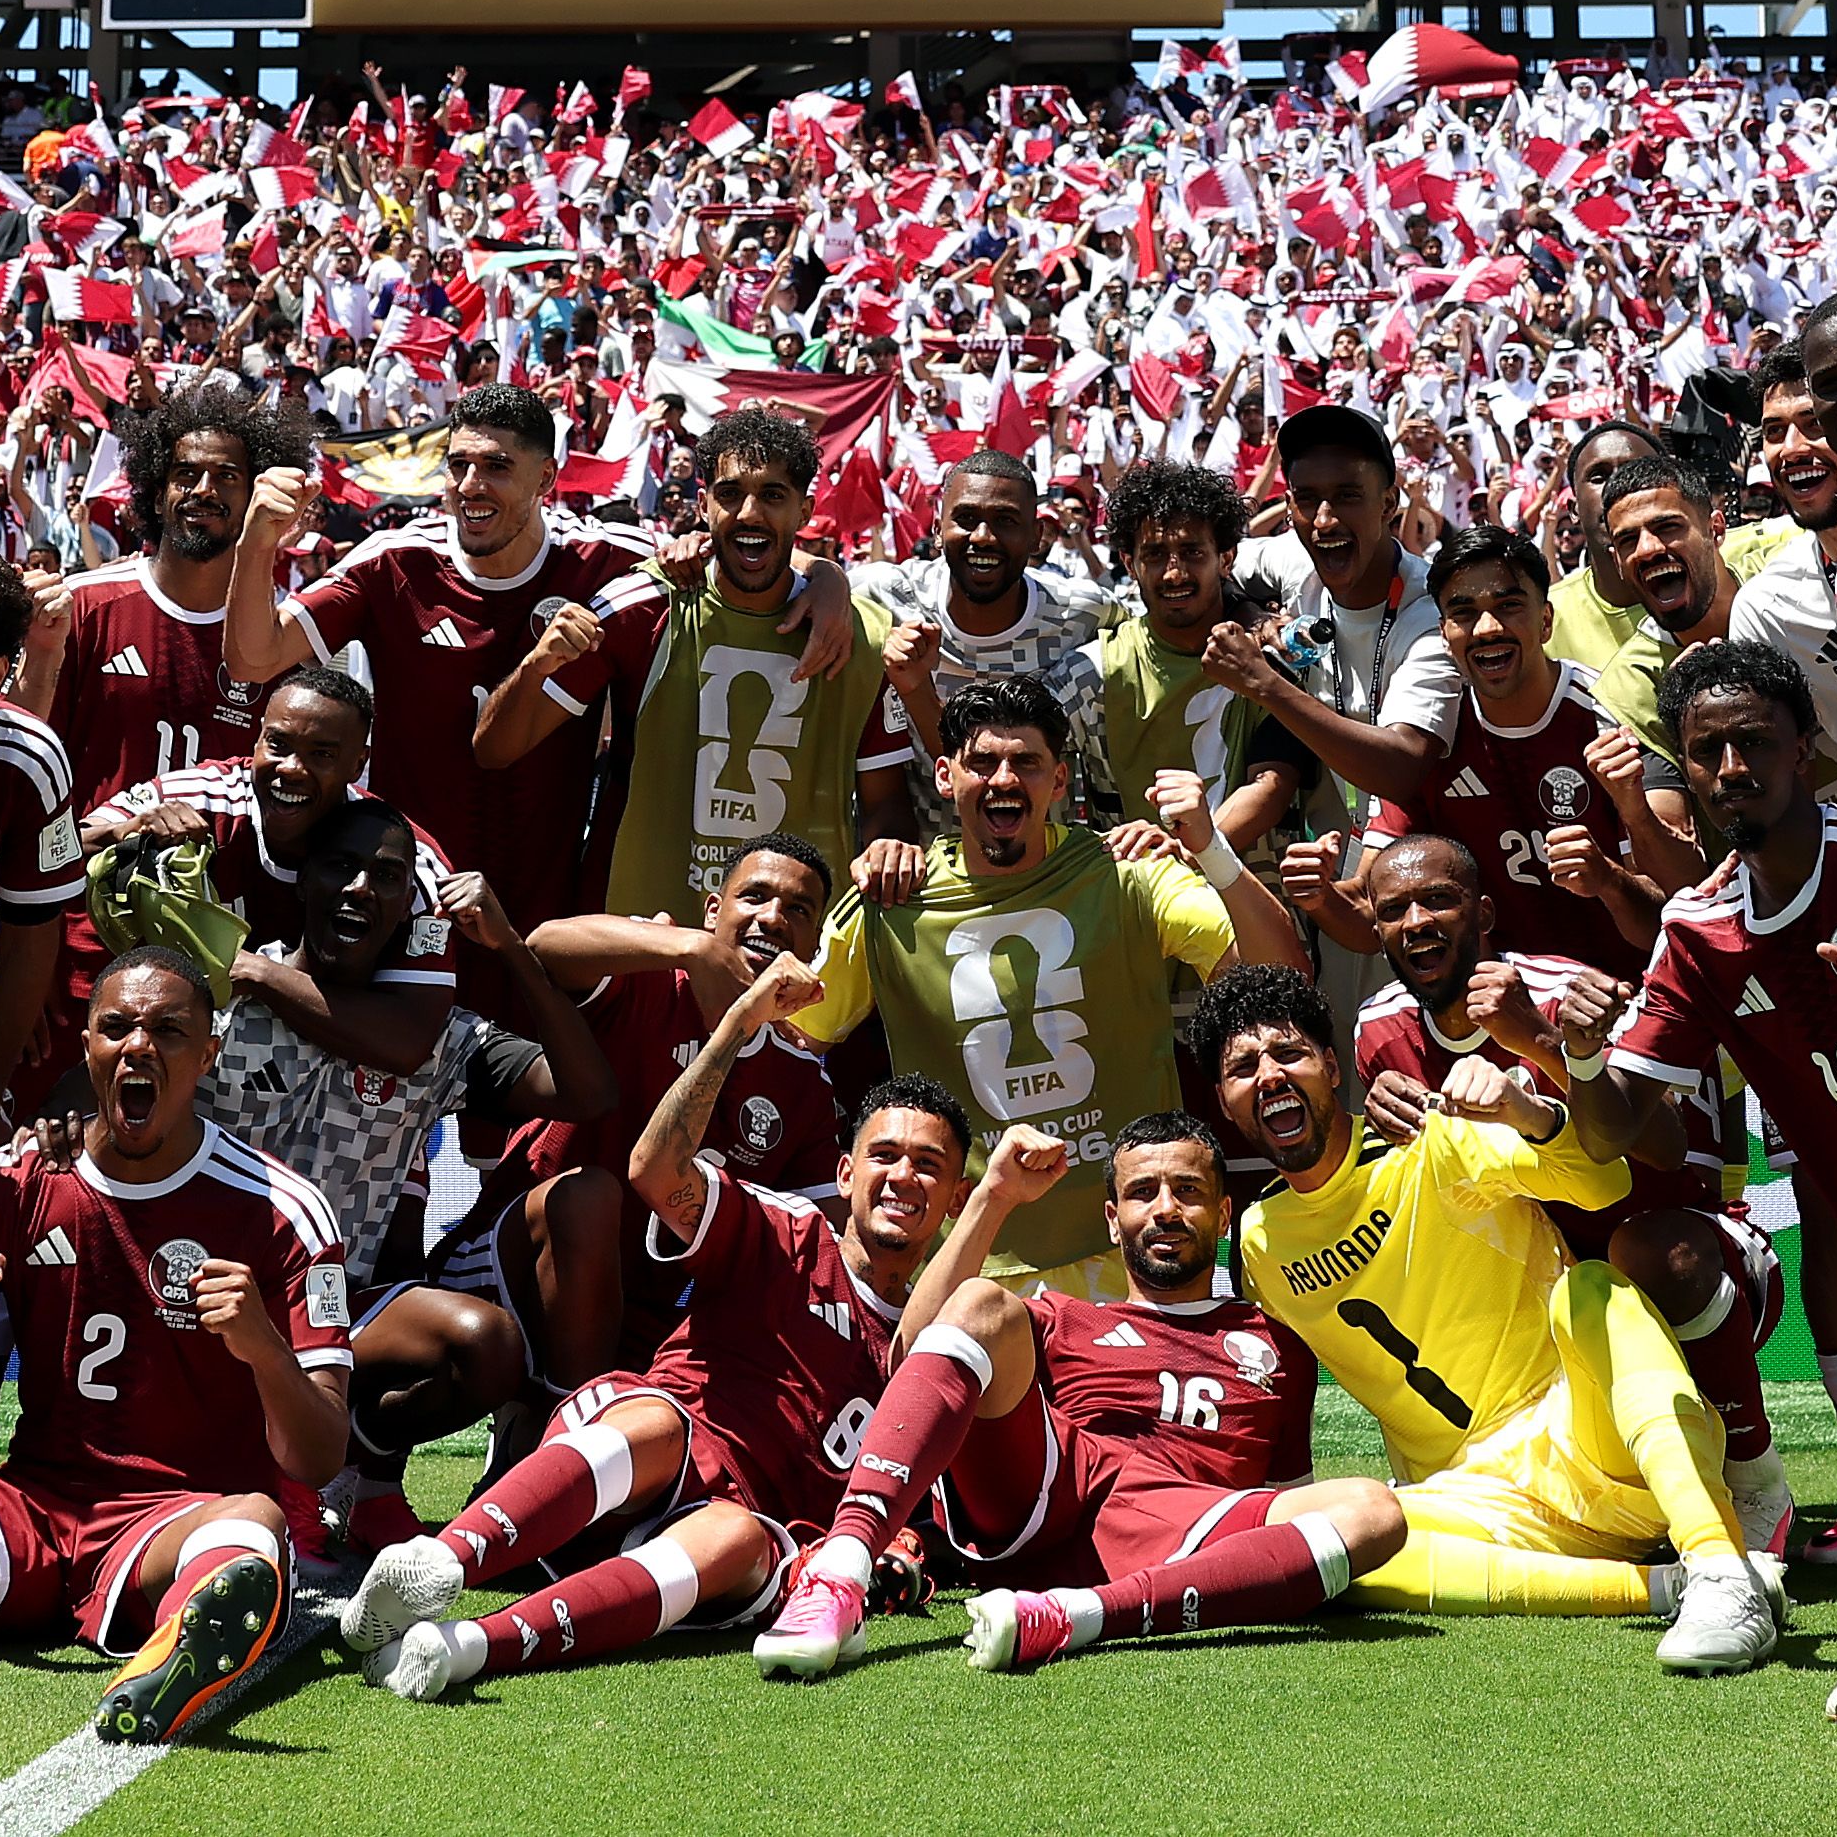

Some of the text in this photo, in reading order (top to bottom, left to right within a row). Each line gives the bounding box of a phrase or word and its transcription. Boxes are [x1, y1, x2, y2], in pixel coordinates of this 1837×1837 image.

[956, 332, 1024, 352] QATAR
[227, 689, 248, 704] QFA
[157, 720, 199, 776] 11
[710, 798, 757, 823] FIFA
[1552, 804, 1575, 817] QFA
[361, 1091, 381, 1106] QFA
[1005, 1070, 1066, 1101] FIFA
[1063, 1108, 1104, 1134] CUP
[747, 1132, 767, 1149] QFA
[1281, 1208, 1392, 1297] ABUNADA
[162, 1285, 189, 1301] QFA
[320, 1303, 340, 1313] PEACE
[78, 1313, 126, 1401] 2
[1336, 1298, 1473, 1430] 1
[1158, 1371, 1225, 1432] 16
[860, 1453, 910, 1485] QFA
[481, 1501, 519, 1547] QFA
[1182, 1586, 1199, 1631] QFA
[550, 1598, 575, 1653] QFA
